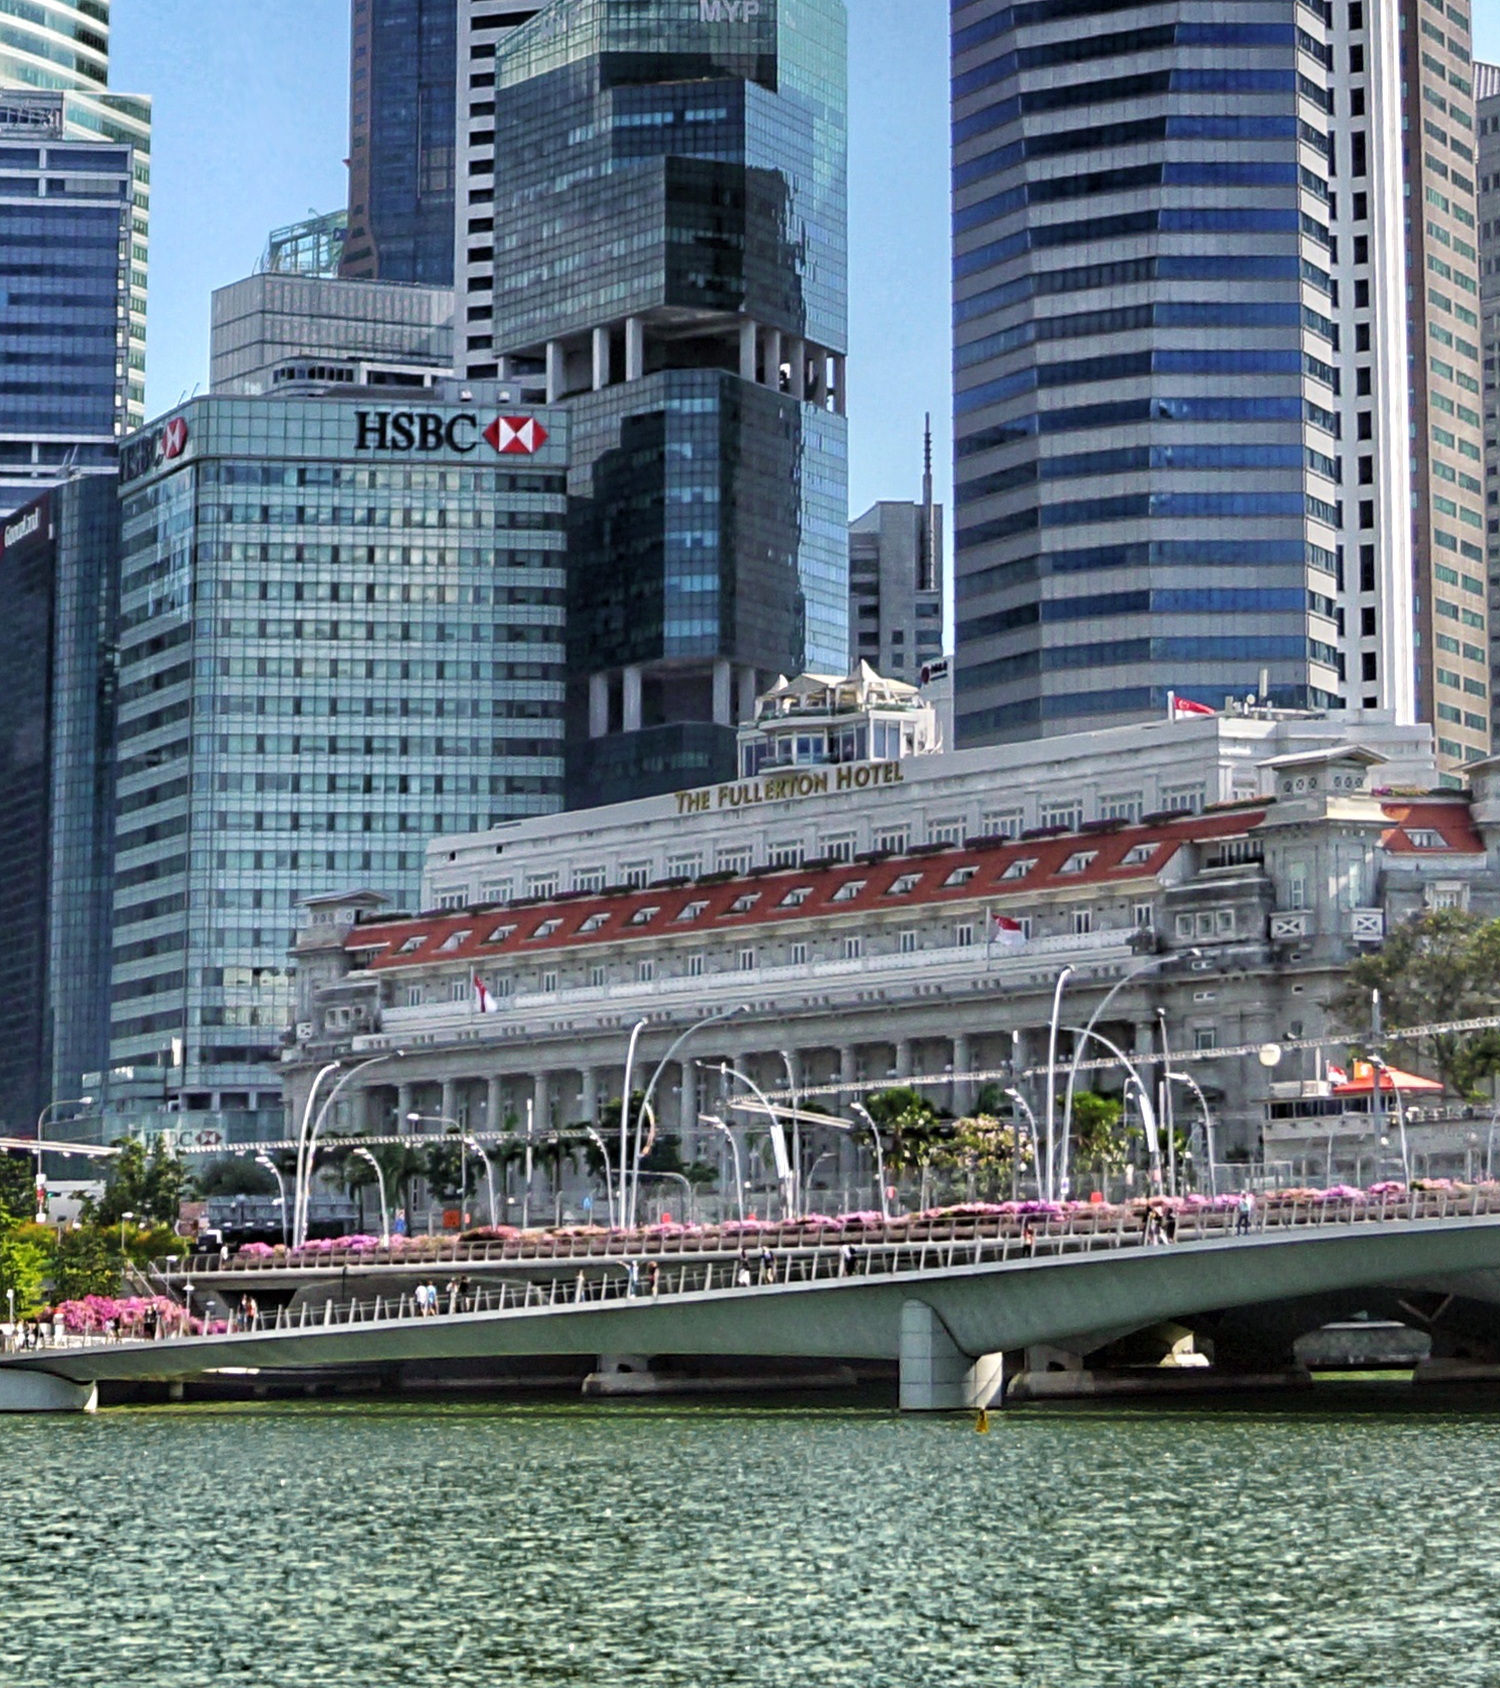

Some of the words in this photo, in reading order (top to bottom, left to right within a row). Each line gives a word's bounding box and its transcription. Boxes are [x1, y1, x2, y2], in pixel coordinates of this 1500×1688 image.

[354, 411, 478, 453] HSBC
[675, 790, 710, 814] THE
[718, 771, 828, 808] FULLERTON
[836, 761, 904, 791] HOTEL
